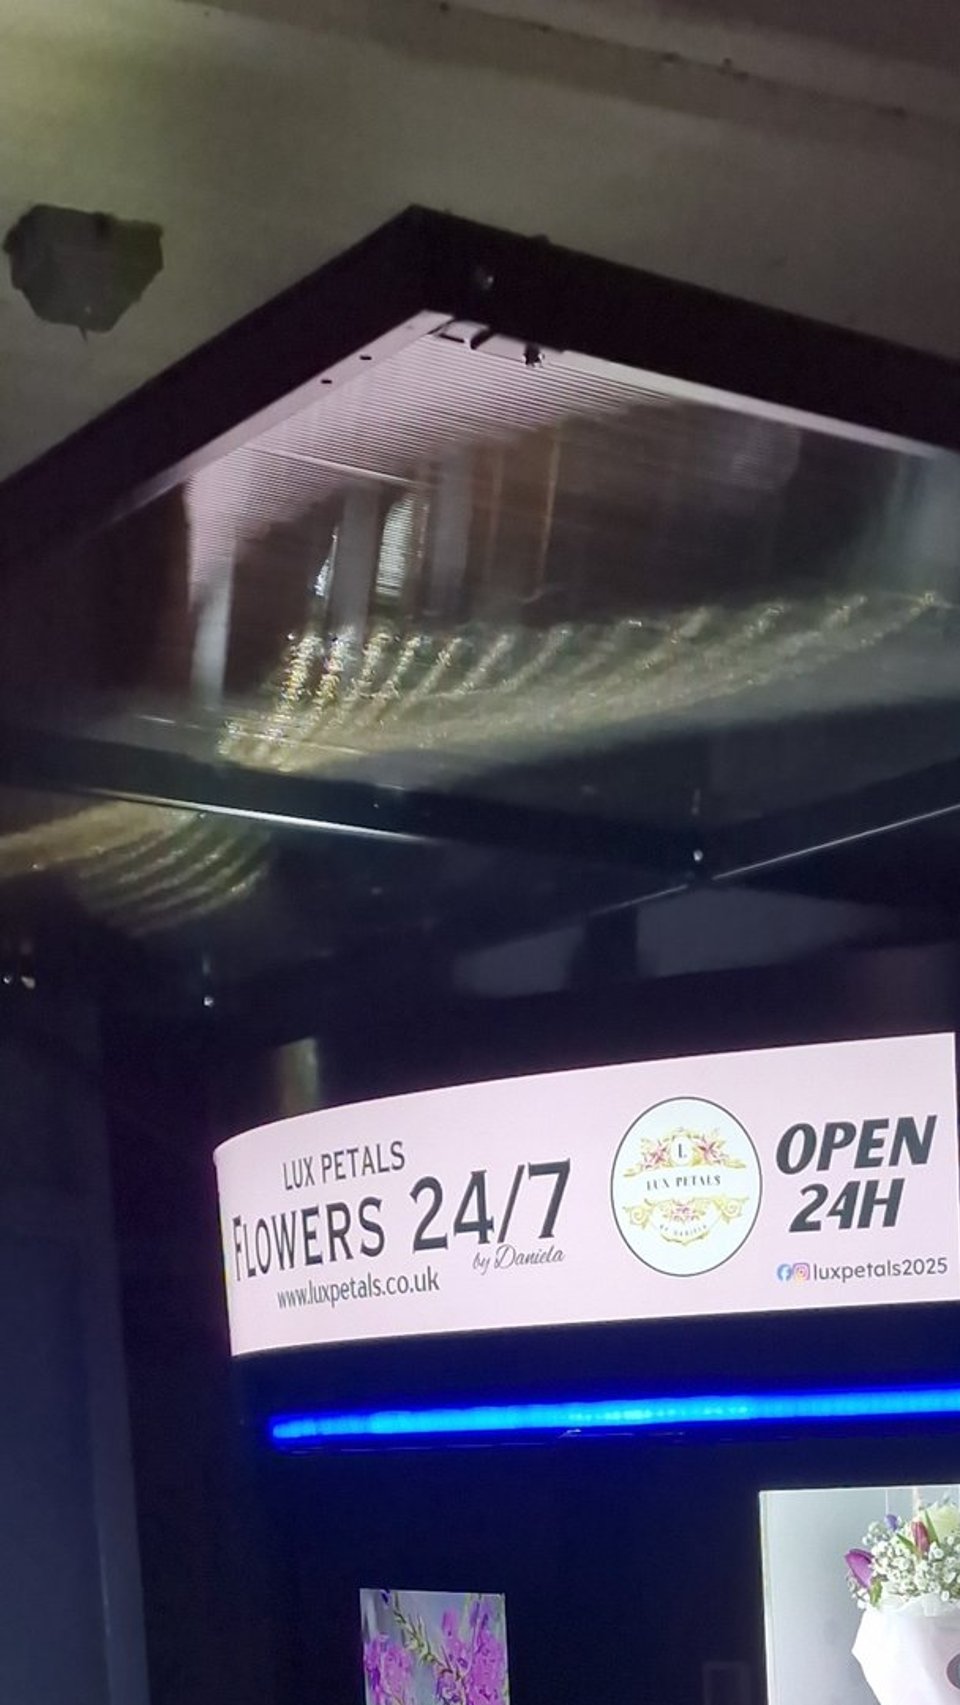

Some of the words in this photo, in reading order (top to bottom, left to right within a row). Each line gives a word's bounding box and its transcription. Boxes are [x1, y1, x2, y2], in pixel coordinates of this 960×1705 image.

[282, 1156, 316, 1191] LUX
[321, 1140, 406, 1184] PETALS
[775, 1115, 937, 1175] OPEN
[676, 1174, 721, 1188] PETALS
[232, 1196, 386, 1282] FLOWERS
[409, 1158, 571, 1252] 24/7
[788, 1178, 905, 1233] 24H
[472, 1252, 491, 1276] by
[493, 1243, 566, 1270] Daniela
[812, 1257, 948, 1283] luxpetals2025
[276, 1265, 441, 1309] www.luxpetals.co.uk
